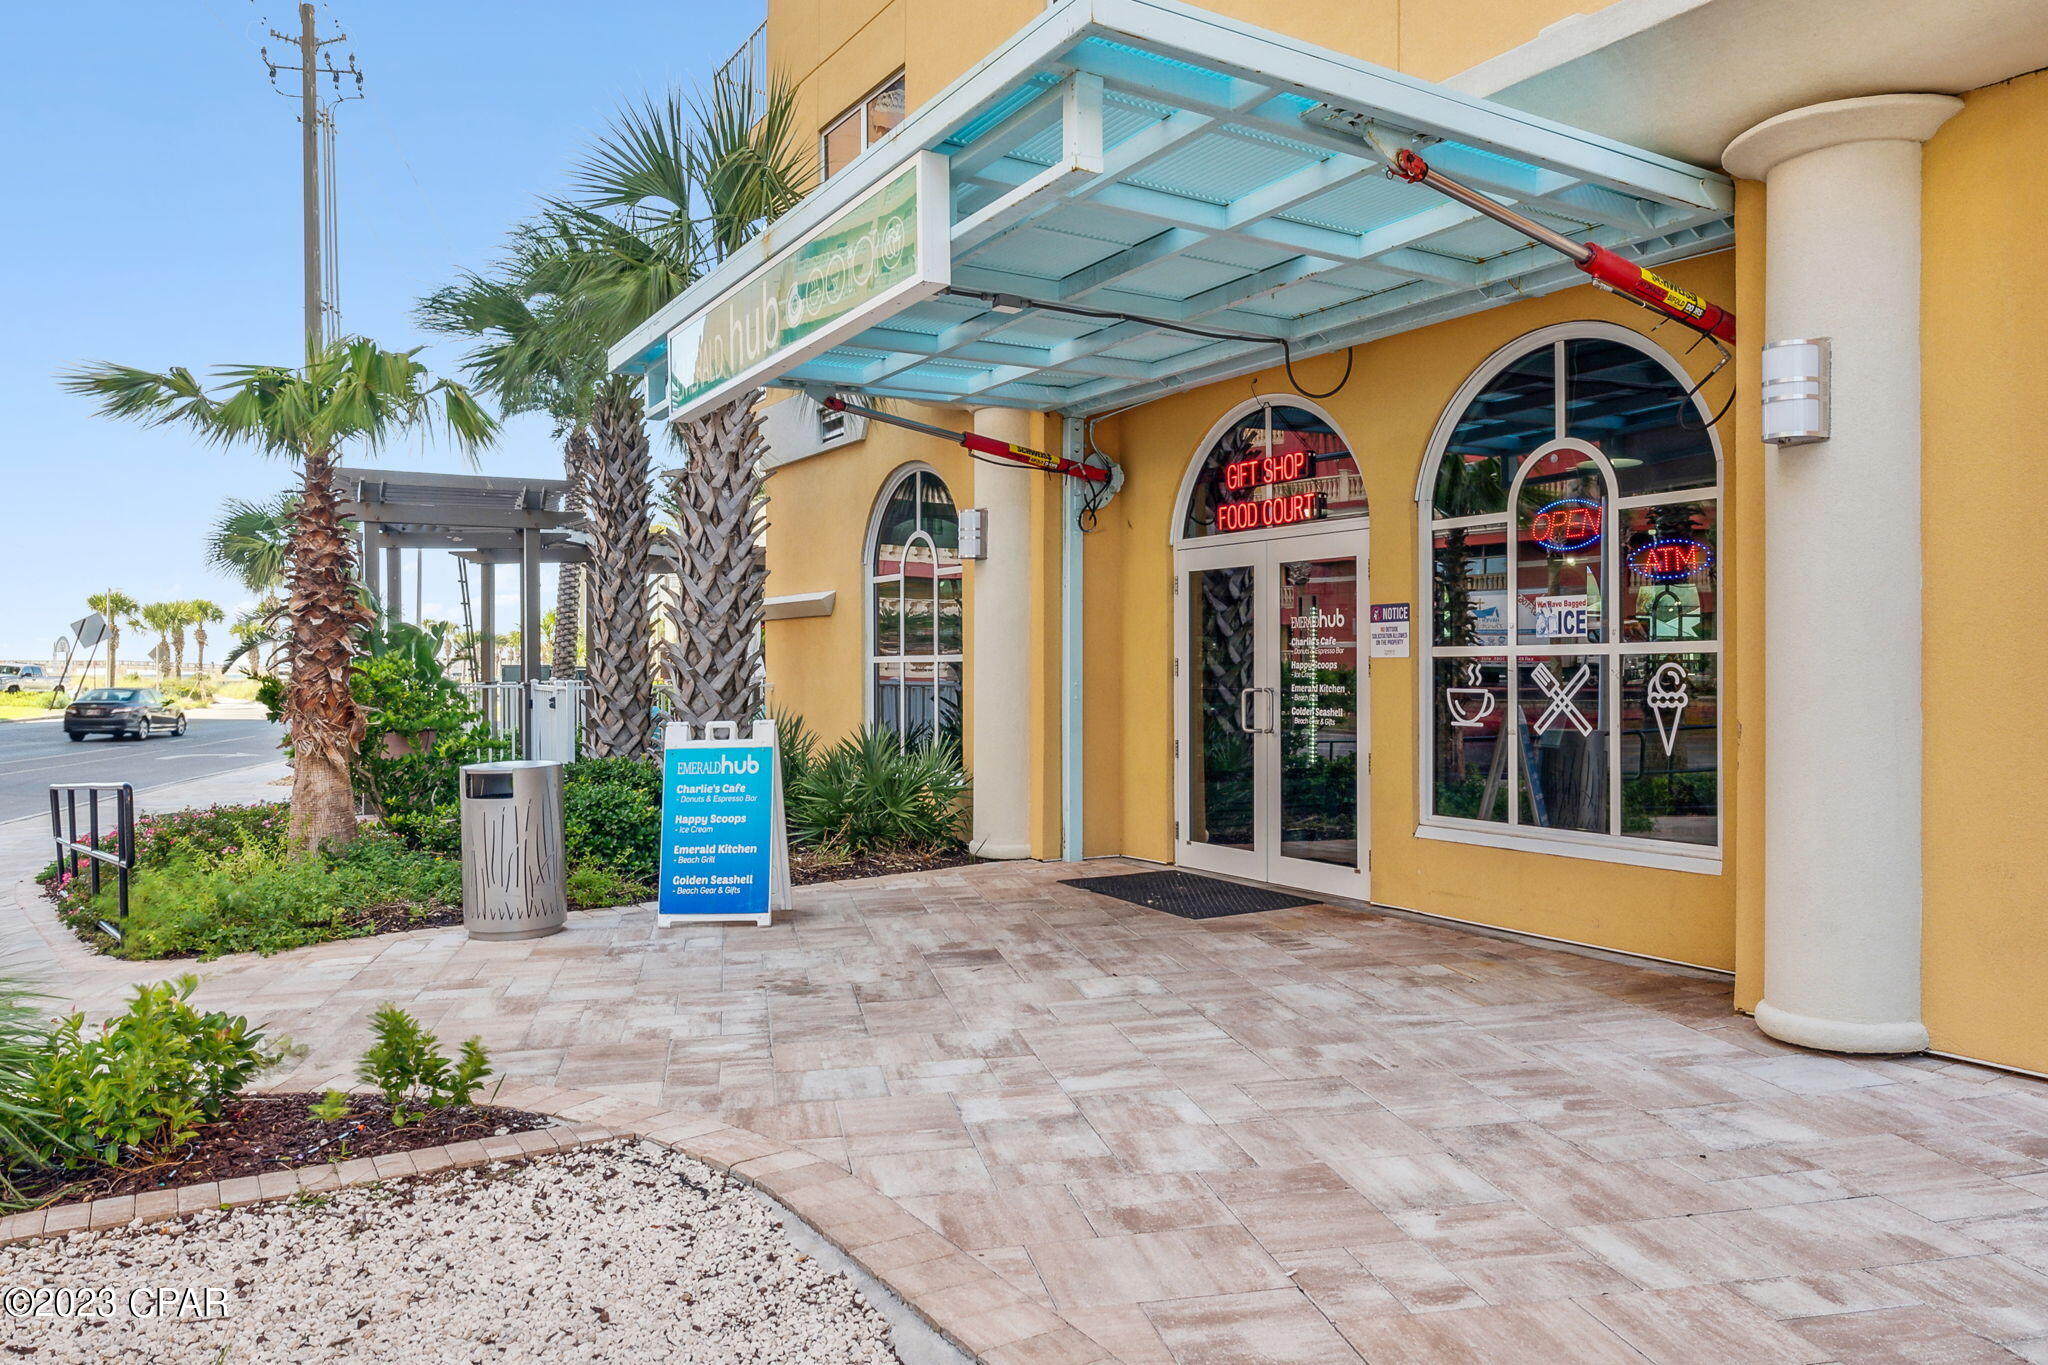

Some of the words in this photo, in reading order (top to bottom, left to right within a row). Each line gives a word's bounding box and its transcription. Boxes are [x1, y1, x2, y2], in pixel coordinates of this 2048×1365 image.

[1226, 460, 1258, 491] GIFT
[1263, 452, 1305, 484] SHOP
[1218, 502, 1258, 531] FOOD
[1262, 493, 1315, 526] COURT
[1531, 506, 1602, 541] OPEN
[1644, 546, 1697, 573] ATM
[1563, 599, 1587, 608] Bagged
[1382, 606, 1408, 620] NOTICE
[1557, 610, 1586, 635] ICE
[1320, 636, 1337, 646] Cafe
[1319, 684, 1346, 693] Kitchen
[1315, 708, 1344, 717] Seashell
[1324, 718, 1336, 726] Gifts
[676, 784, 720, 794] Charlie's
[722, 783, 746, 793] Cafe
[680, 795, 705, 803] Donuts
[706, 795, 712, 803] &
[713, 795, 744, 804] Espresso
[744, 794, 758, 802] Bar
[675, 814, 708, 826] Happy
[710, 814, 747, 825] Scoops
[679, 825, 690, 834] Ice
[691, 825, 714, 833] Cream
[673, 844, 716, 855] Emerald
[718, 843, 758, 854] Kitchen
[678, 856, 700, 864] Beach
[701, 855, 716, 863] Grill
[672, 875, 709, 885] Golden
[710, 874, 753, 884] Seashell
[677, 886, 699, 895] Beach
[700, 886, 717, 894] Gear
[717, 886, 723, 894] &
[724, 886, 741, 895] Gifts
